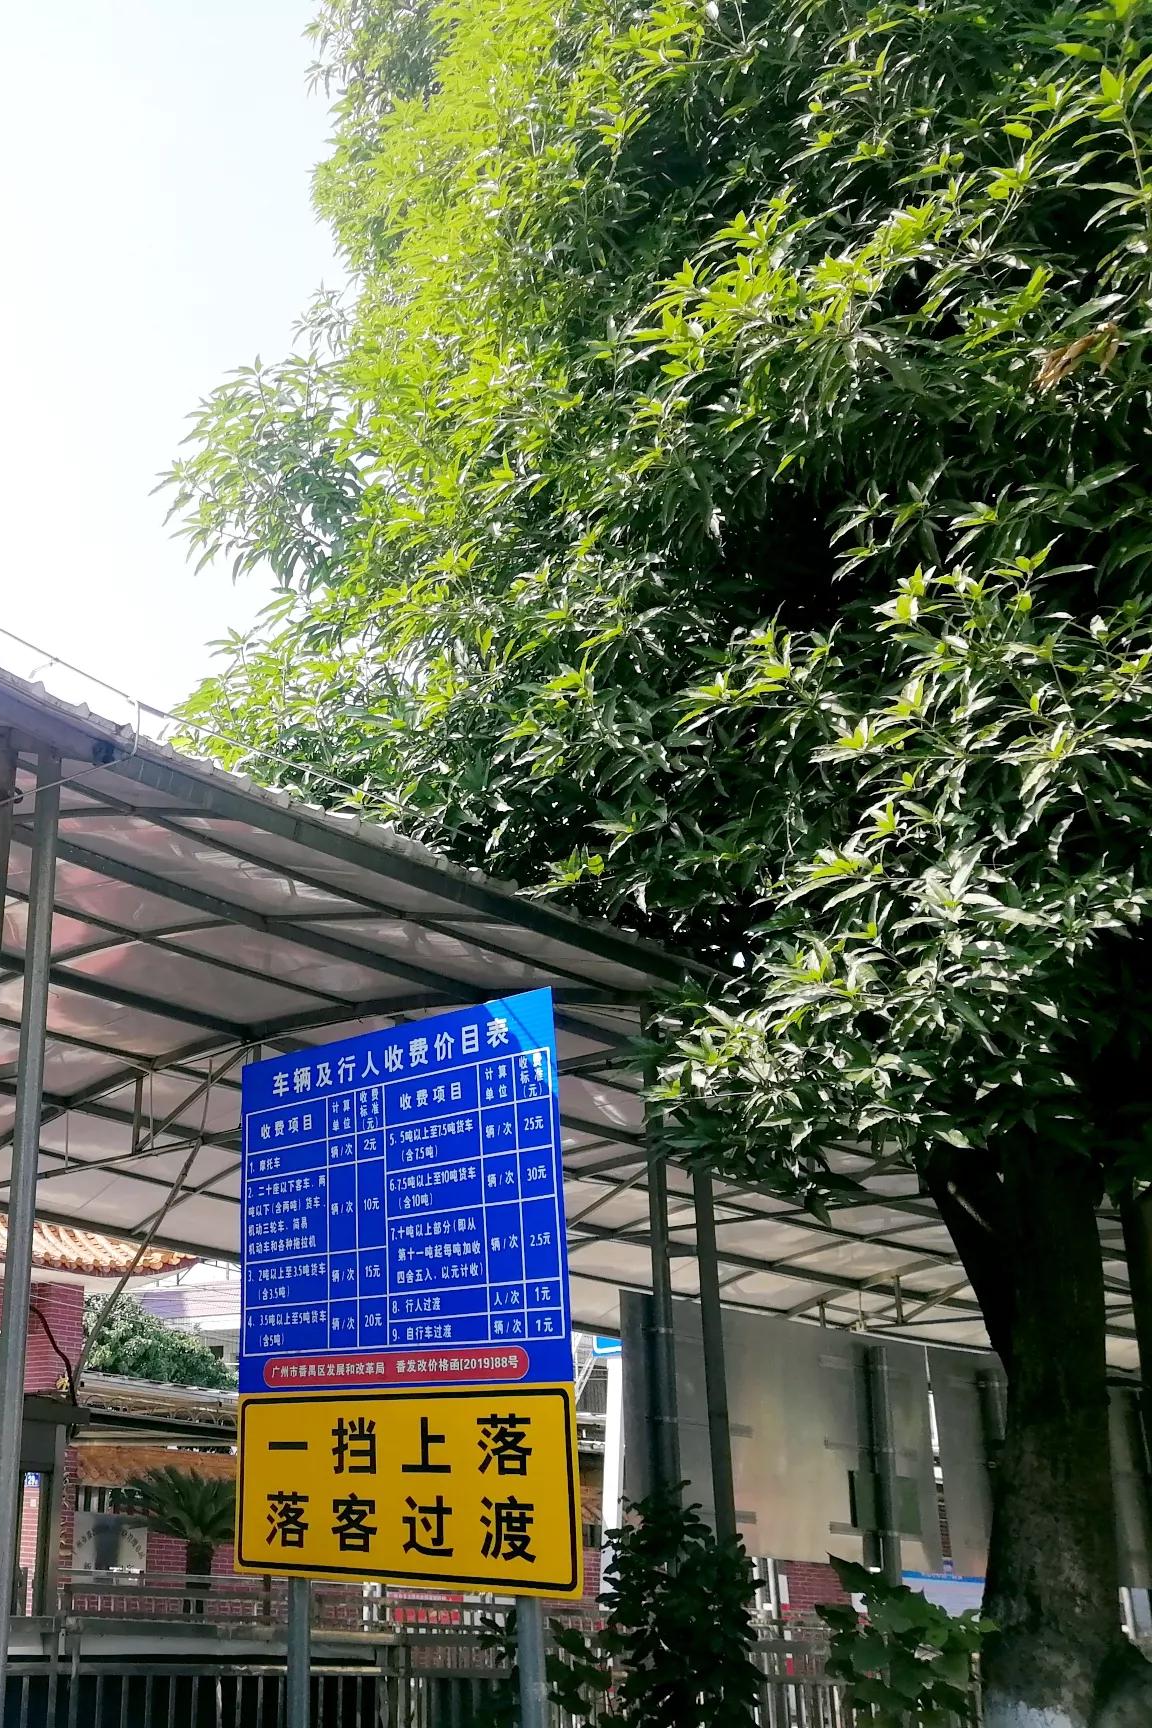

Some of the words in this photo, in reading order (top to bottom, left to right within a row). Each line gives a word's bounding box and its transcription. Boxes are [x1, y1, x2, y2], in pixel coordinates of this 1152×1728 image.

[272, 1017, 509, 1097] 车辆及行人收费价目表
[399, 1081, 462, 1111] 收费项目
[260, 1113, 313, 1140] 收费项目
[485, 1121, 513, 1139] 辆/次
[523, 1115, 544, 1131] 25元
[330, 1144, 353, 1158] 辆/次
[363, 1138, 377, 1151] 2元
[487, 1170, 515, 1188] 辆/次
[526, 1165, 547, 1182] 30元
[330, 1201, 354, 1216] 辆/次
[363, 1197, 380, 1211] 10元
[249, 1235, 317, 1255] 机动车和各种拖拉机
[490, 1234, 519, 1252] 辆/次
[530, 1232, 551, 1248] 2.5元
[397, 1240, 481, 1261] 第十一吨起每吨加收
[331, 1268, 355, 1283] 辆/次
[364, 1264, 381, 1278] 15元
[493, 1290, 520, 1306] 人/次
[534, 1286, 551, 1302] 1元
[332, 1317, 355, 1331] 辆/次
[364, 1313, 382, 1328] 20元
[494, 1319, 522, 1335] 辆/次
[535, 1317, 554, 1333] 1元
[271, 1361, 385, 1379] 广州市番禺区发展和改革局
[268, 1413, 533, 1476] 一挡上落
[265, 1490, 537, 1564] 落客过渡
